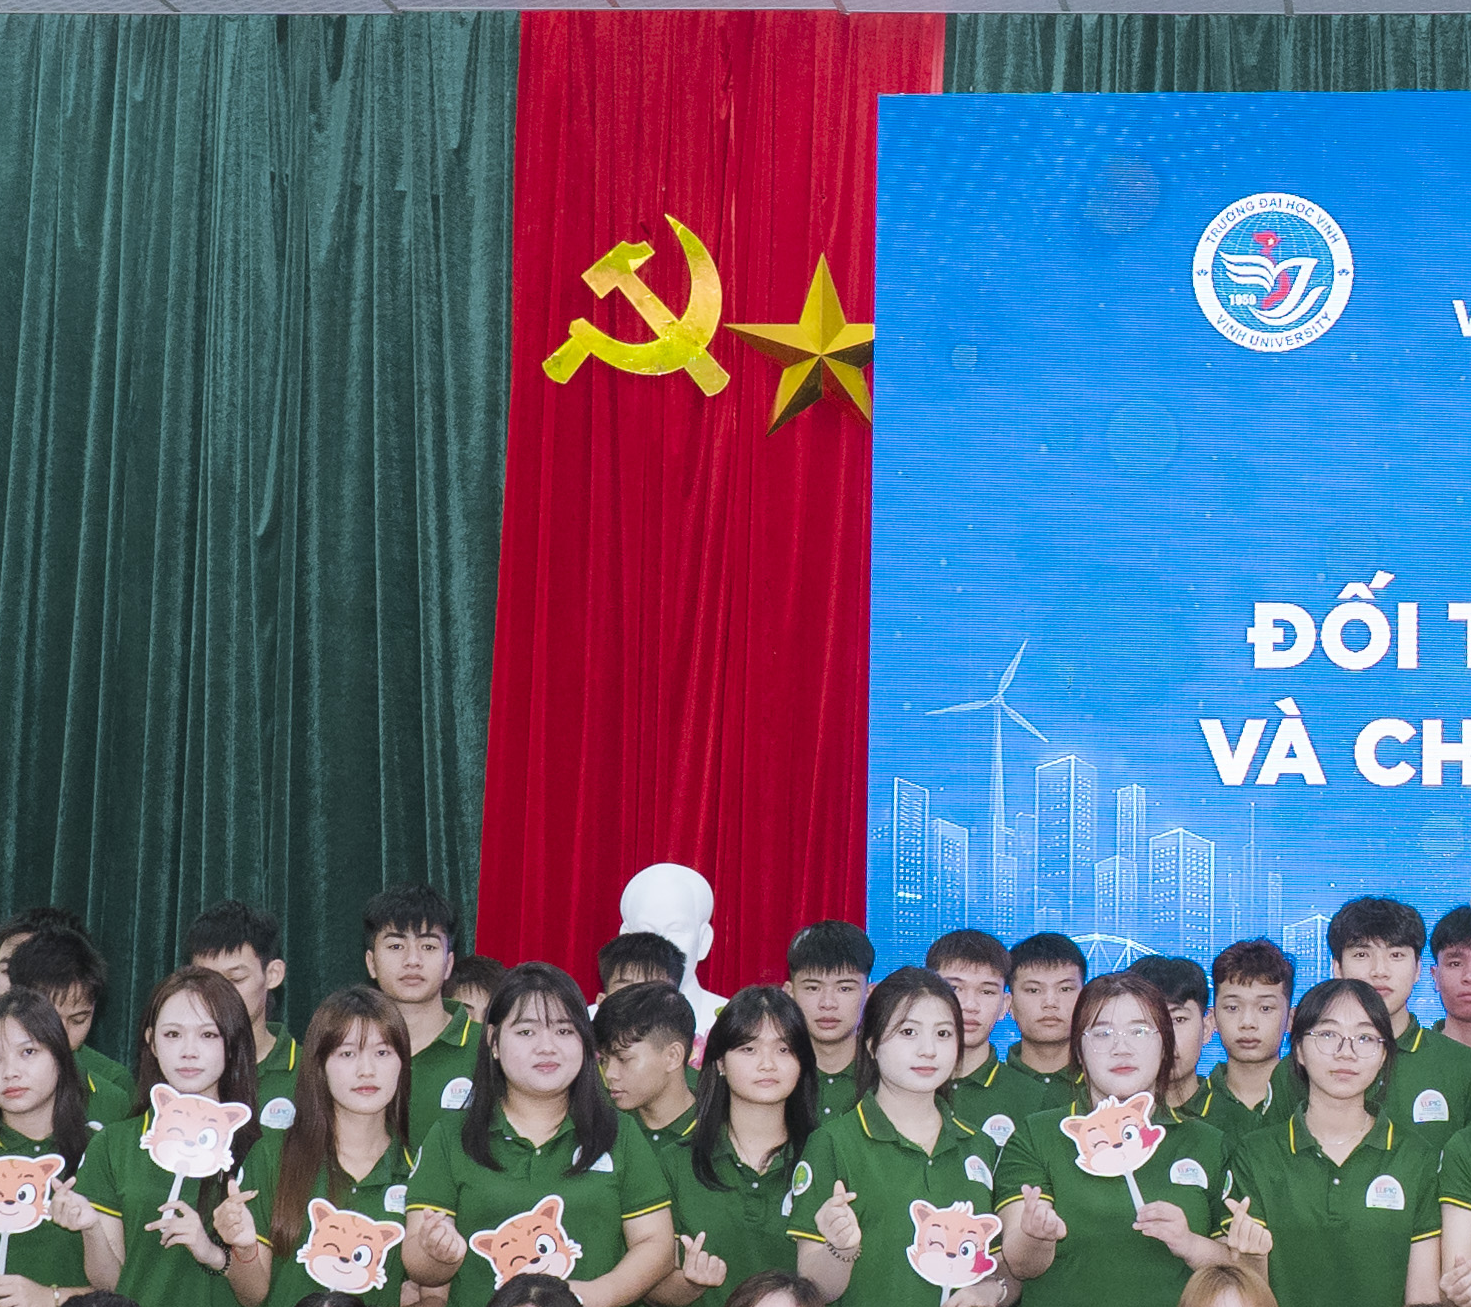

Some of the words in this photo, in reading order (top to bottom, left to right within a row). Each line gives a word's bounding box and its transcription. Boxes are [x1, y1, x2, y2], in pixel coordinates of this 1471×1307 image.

[1315, 213, 1344, 245] VINH
[1215, 314, 1247, 343] VINH
[1248, 310, 1333, 349] UNIVERSITY
[1246, 569, 1420, 671] ĐỐI
[1198, 697, 1327, 789] VÀ
